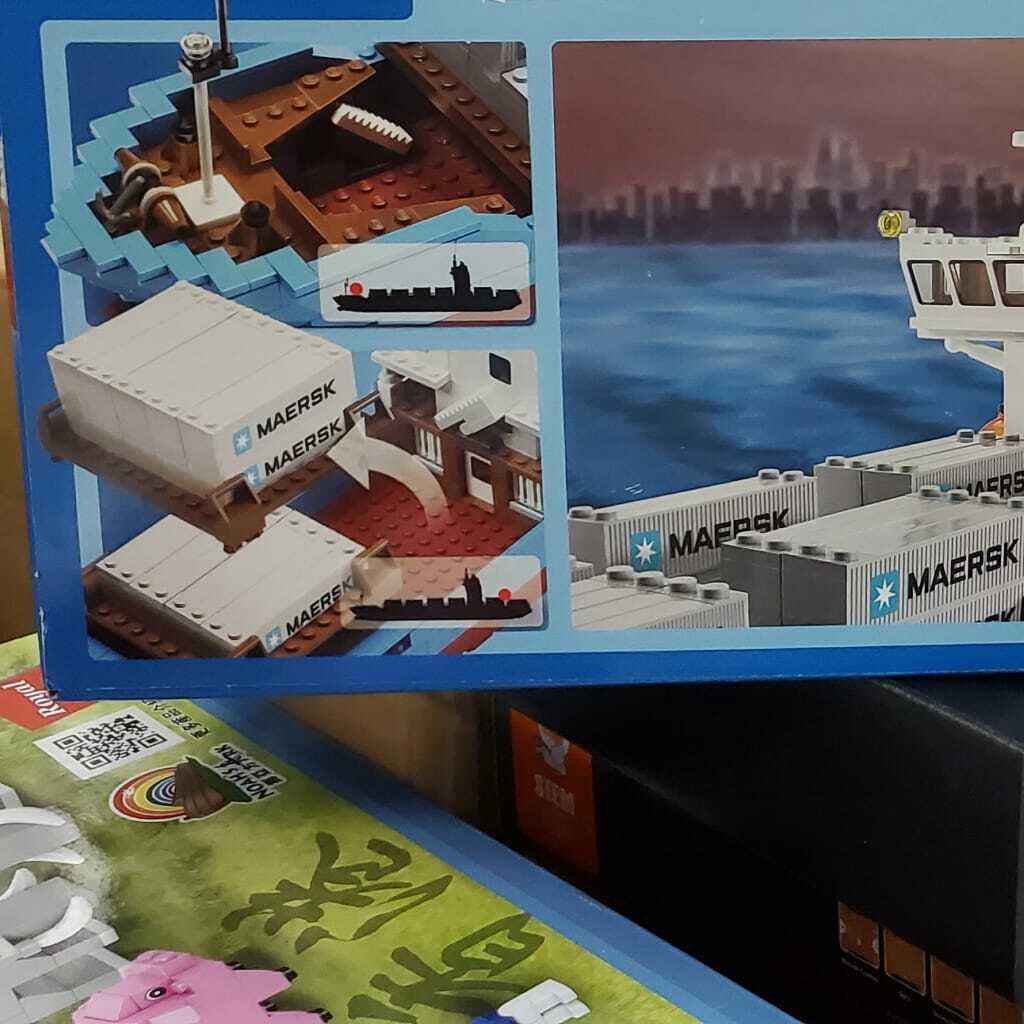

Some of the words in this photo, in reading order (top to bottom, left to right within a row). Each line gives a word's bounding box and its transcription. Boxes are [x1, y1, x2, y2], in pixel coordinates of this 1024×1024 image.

[256, 378, 337, 439] MAERSK
[264, 417, 343, 477] MAERSK
[907, 538, 1020, 600] MAERSK
[1, 679, 67, 718] Royal
